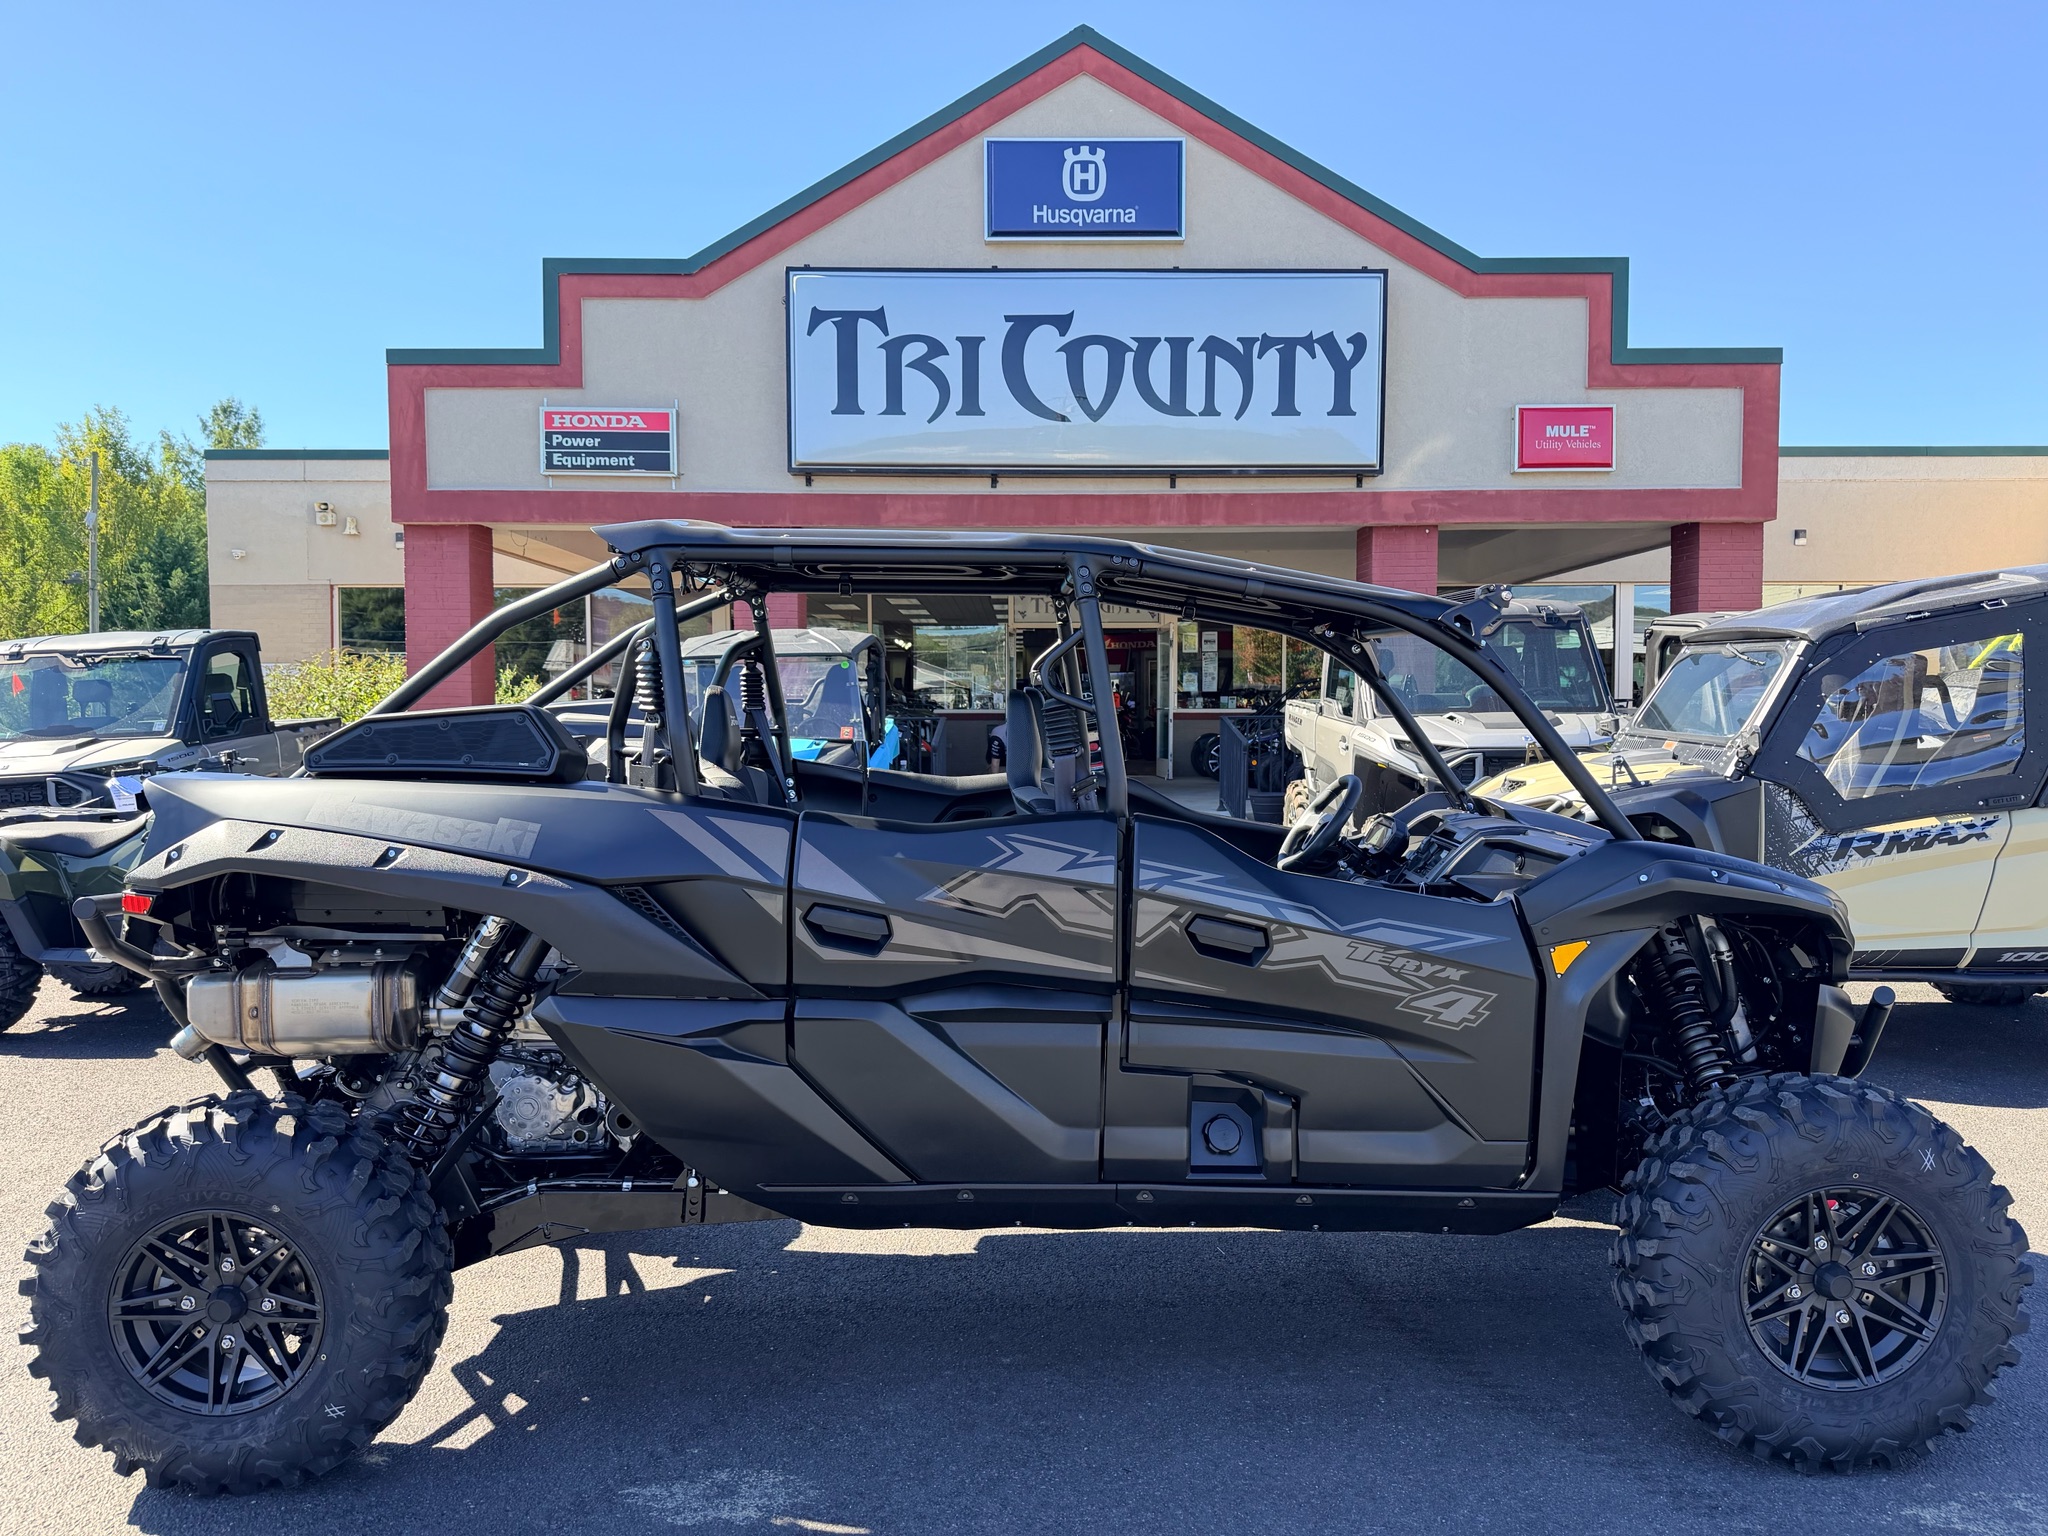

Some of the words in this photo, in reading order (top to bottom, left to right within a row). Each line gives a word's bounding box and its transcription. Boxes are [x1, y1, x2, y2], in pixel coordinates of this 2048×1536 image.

[1033, 204, 1136, 227] Husqvarna
[806, 305, 986, 424] TRI
[1001, 308, 1368, 423] COUNTY
[551, 414, 647, 428] HONDA
[552, 434, 601, 447] Power
[1535, 440, 1564, 451] Utility
[1566, 439, 1602, 449] Vehicles
[552, 453, 635, 468] Equipment
[1110, 640, 1157, 649] HONDA
[167, 751, 195, 762] 1500
[1402, 986, 1487, 1027] 4
